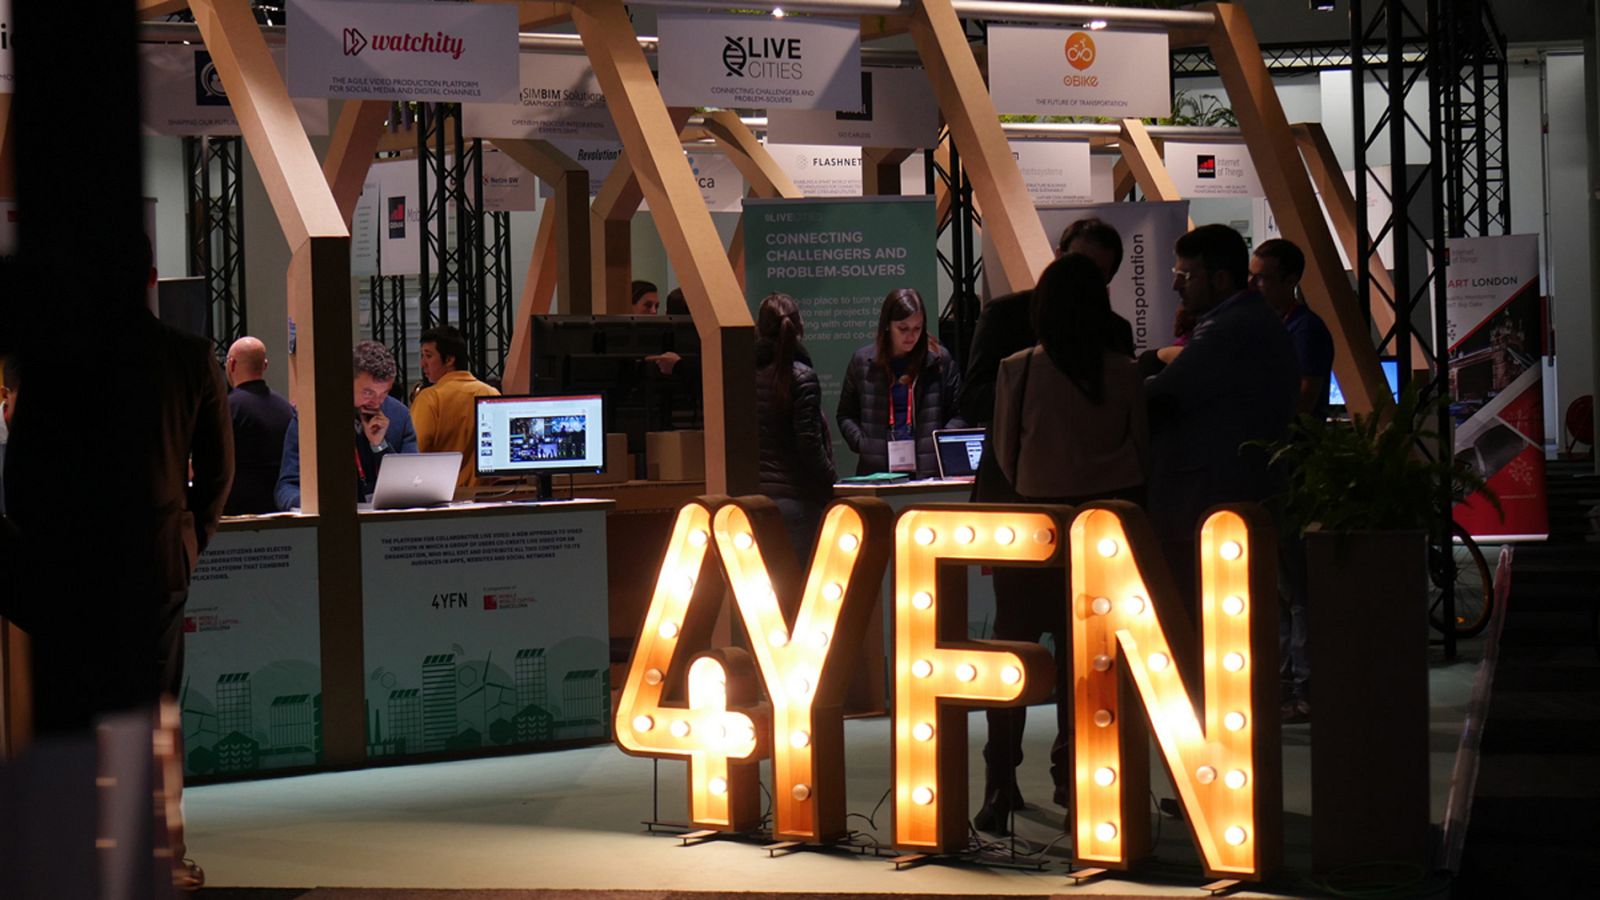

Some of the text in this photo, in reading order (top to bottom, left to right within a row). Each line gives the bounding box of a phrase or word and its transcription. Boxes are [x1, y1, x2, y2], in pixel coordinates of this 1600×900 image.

[371, 31, 465, 60] watchity
[748, 37, 802, 59] LIVE
[748, 61, 803, 80] CITIES
[347, 77, 368, 85] AGILE
[369, 77, 392, 86] VIDEO
[393, 78, 441, 87] PRODUCTION
[442, 80, 479, 88] PLATFORM
[329, 84, 344, 92] FOR
[345, 85, 371, 93] SOCIAL
[372, 86, 396, 94] MEDIA
[397, 87, 414, 95] AND
[442, 88, 482, 96] CHANNELS
[523, 87, 606, 102] SIMBIM Solutions
[710, 86, 754, 95] CONNECTING
[755, 88, 801, 96] CHALLENGERS
[734, 95, 792, 103] PROBLEM-SOLVERS
[1047, 98, 1068, 106] FUTURE
[1079, 99, 1128, 107] TRANSPORTATION
[812, 157, 862, 167] FLASHNET
[698, 175, 716, 189] ca
[770, 212, 793, 223] LIVE
[766, 231, 863, 245] CONNECTING
[766, 246, 907, 262] CHALLENGERS AND
[767, 263, 906, 279] PROBLEM-SOLVERS
[1447, 275, 1518, 289] ART LONDON
[814, 295, 840, 307] place
[840, 295, 851, 306] to
[852, 295, 871, 305] turn
[833, 307, 870, 318] projects
[393, 536, 422, 544] PLATFORM
[431, 591, 468, 610] 4YFN
[614, 496, 1272, 881] 4YFN
